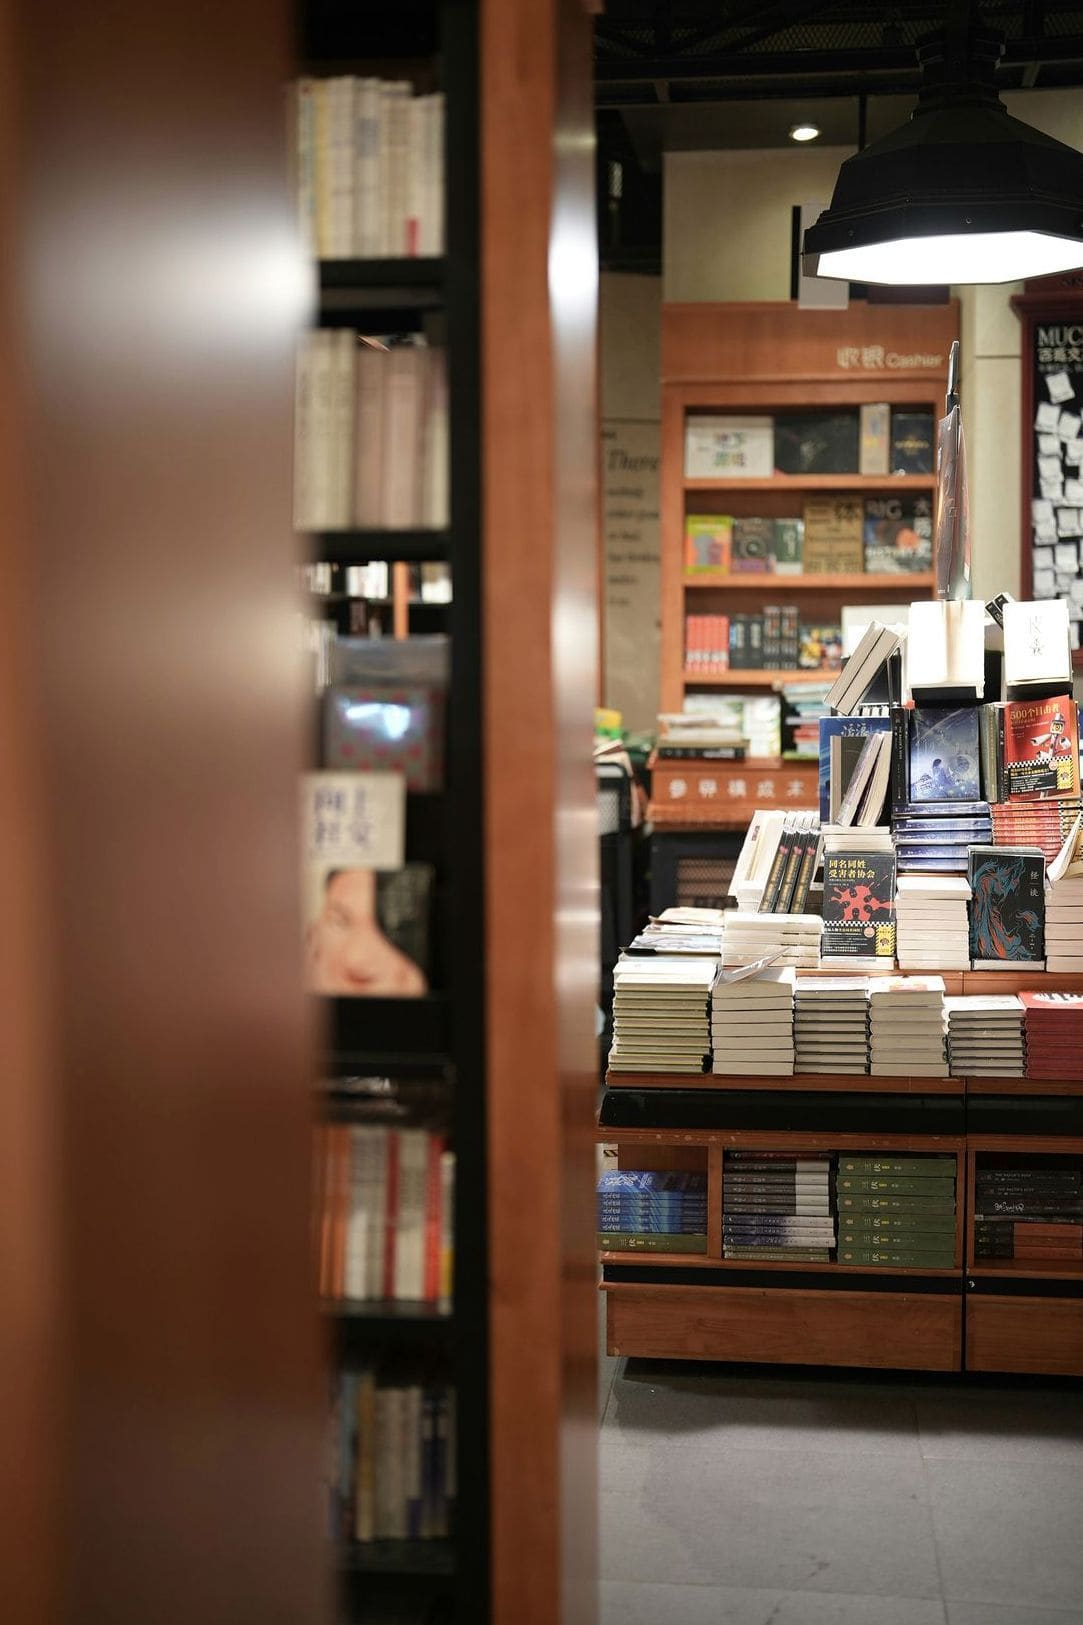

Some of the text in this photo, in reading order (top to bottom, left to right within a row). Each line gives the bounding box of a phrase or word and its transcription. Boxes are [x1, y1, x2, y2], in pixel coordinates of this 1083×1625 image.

[829, 859, 867, 869] 同名同姓
[829, 869, 876, 879] 受害者协会
